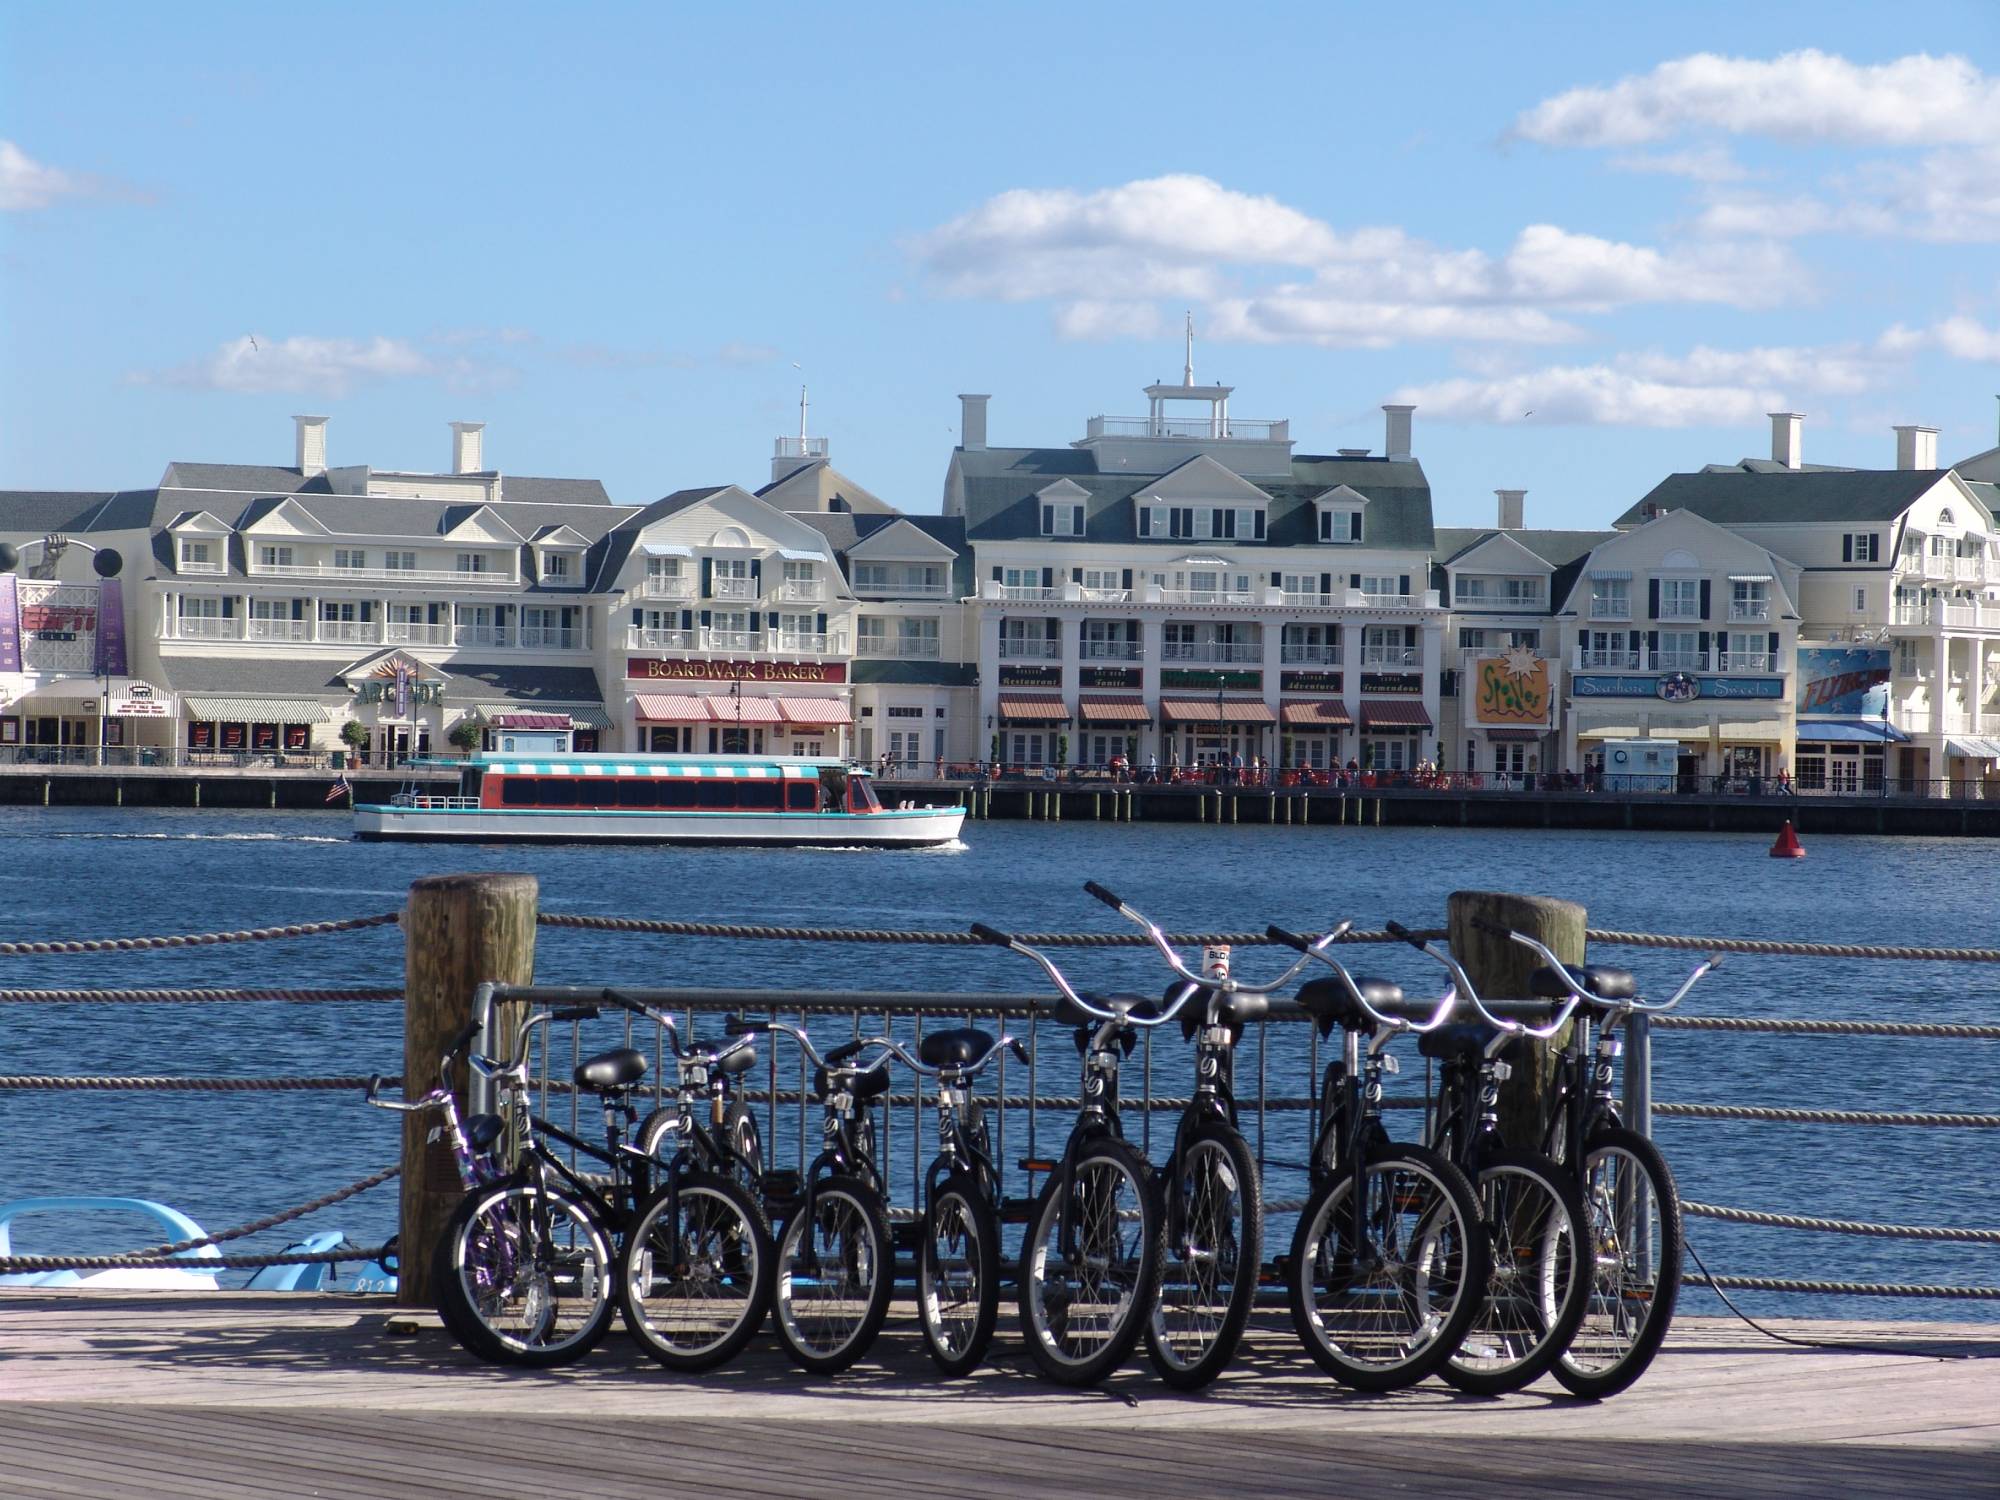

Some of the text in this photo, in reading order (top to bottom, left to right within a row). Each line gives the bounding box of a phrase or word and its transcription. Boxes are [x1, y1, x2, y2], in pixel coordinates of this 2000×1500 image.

[22, 606, 96, 632] ESPN
[647, 660, 828, 681] BOARDWALK BAKERY
[1001, 677, 1058, 686] Restaurant
[1287, 681, 1336, 690] Adventure
[1363, 683, 1420, 692] Tremendous
